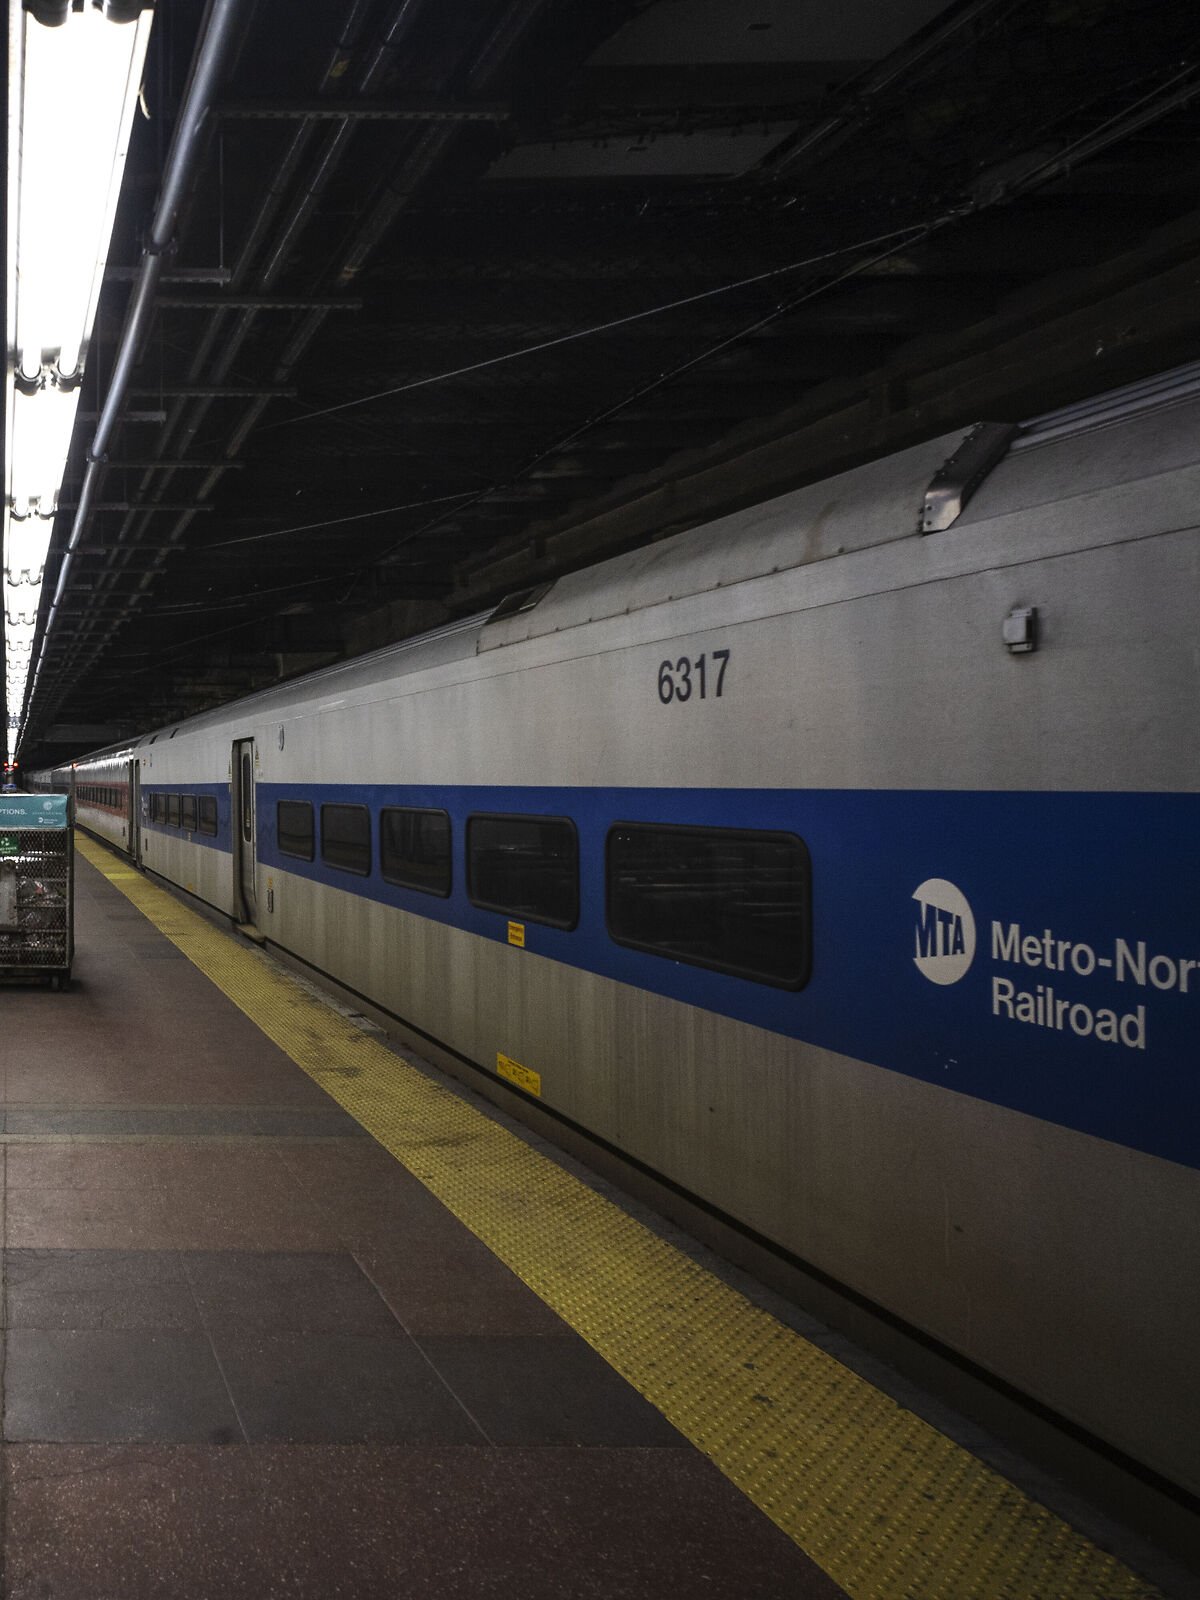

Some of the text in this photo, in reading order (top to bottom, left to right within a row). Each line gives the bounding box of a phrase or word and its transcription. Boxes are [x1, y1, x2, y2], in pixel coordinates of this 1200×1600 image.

[658, 649, 730, 704] 6317
[912, 900, 966, 958] MTA
[991, 920, 1200, 993] Metro-Nor
[991, 976, 1147, 1049] Railroad
